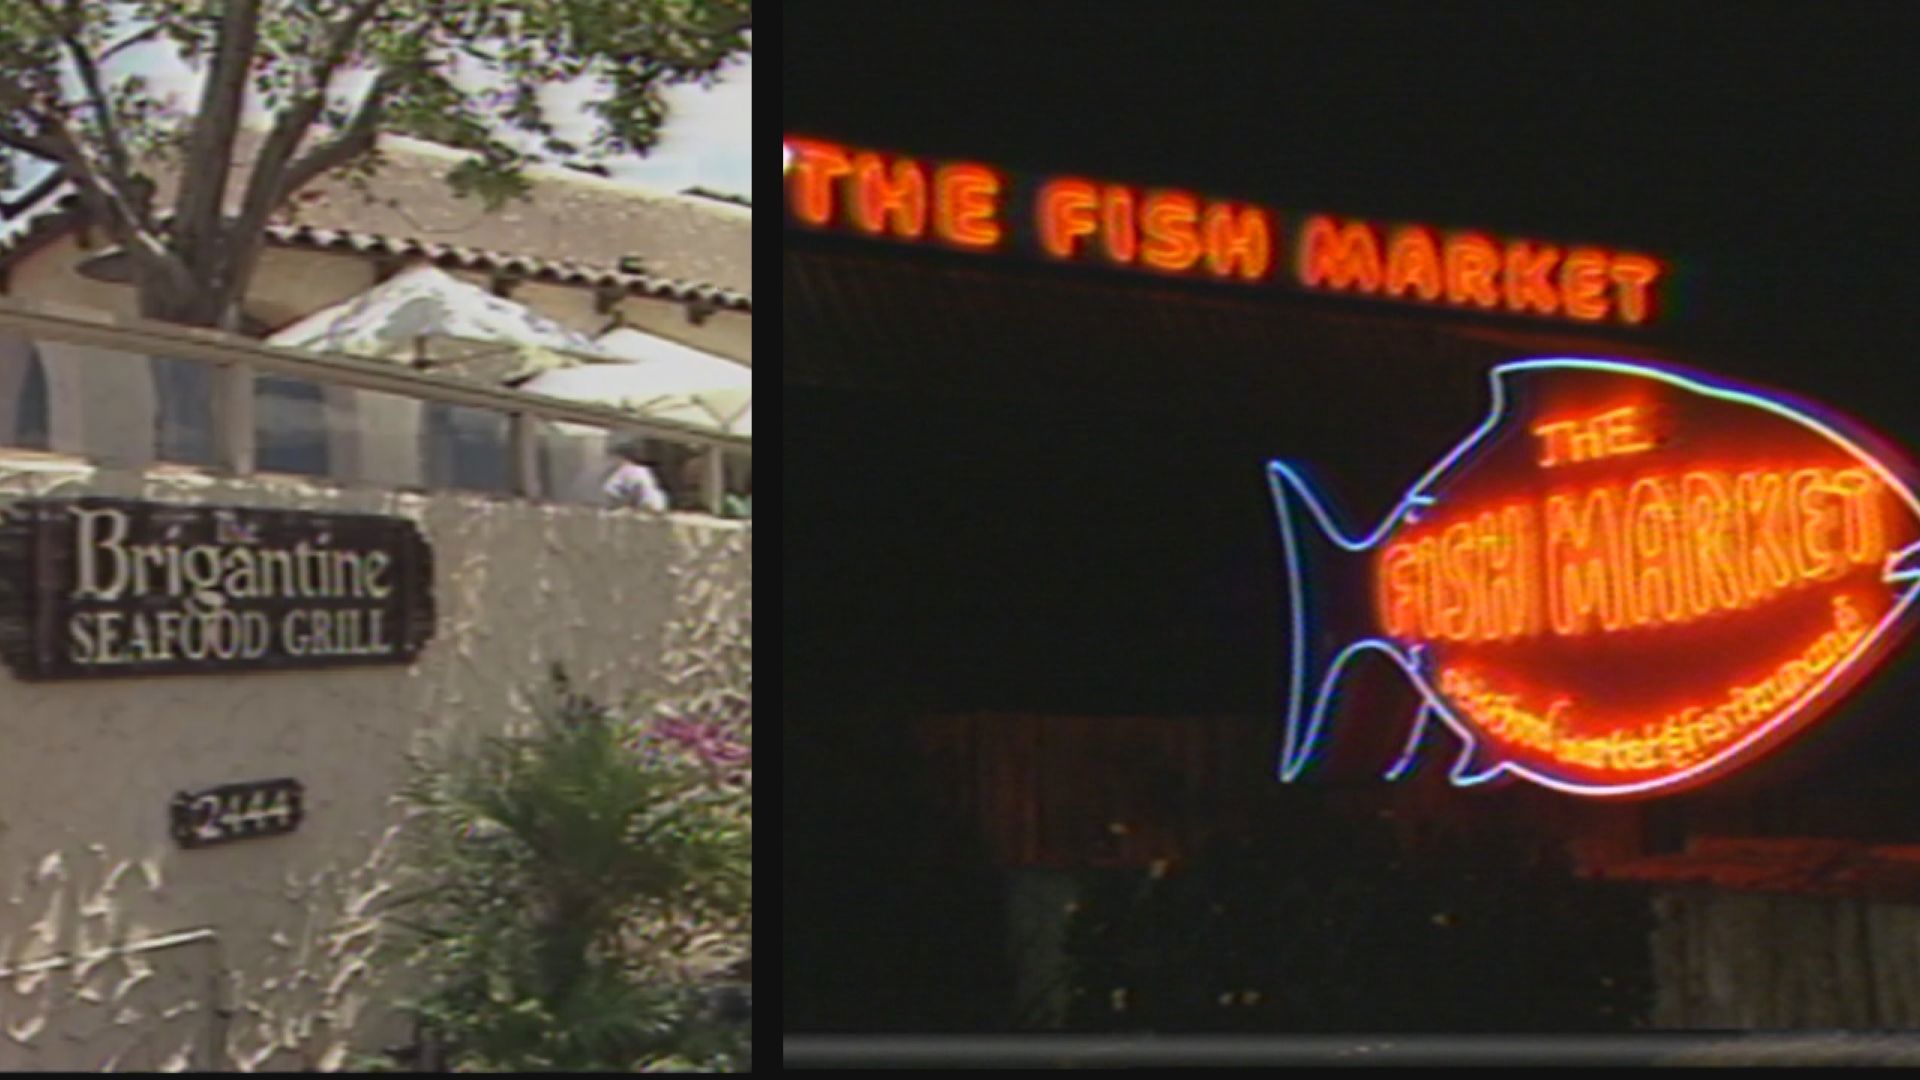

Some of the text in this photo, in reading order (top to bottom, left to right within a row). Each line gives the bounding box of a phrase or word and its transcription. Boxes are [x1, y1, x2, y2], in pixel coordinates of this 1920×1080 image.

[786, 138, 1662, 325] THE FISH MARKET
[1532, 405, 1653, 468] THE
[68, 507, 393, 614] Brigantine
[1380, 467, 1884, 641] FISH MARKET
[69, 608, 392, 664] SEAFOOD GRILL
